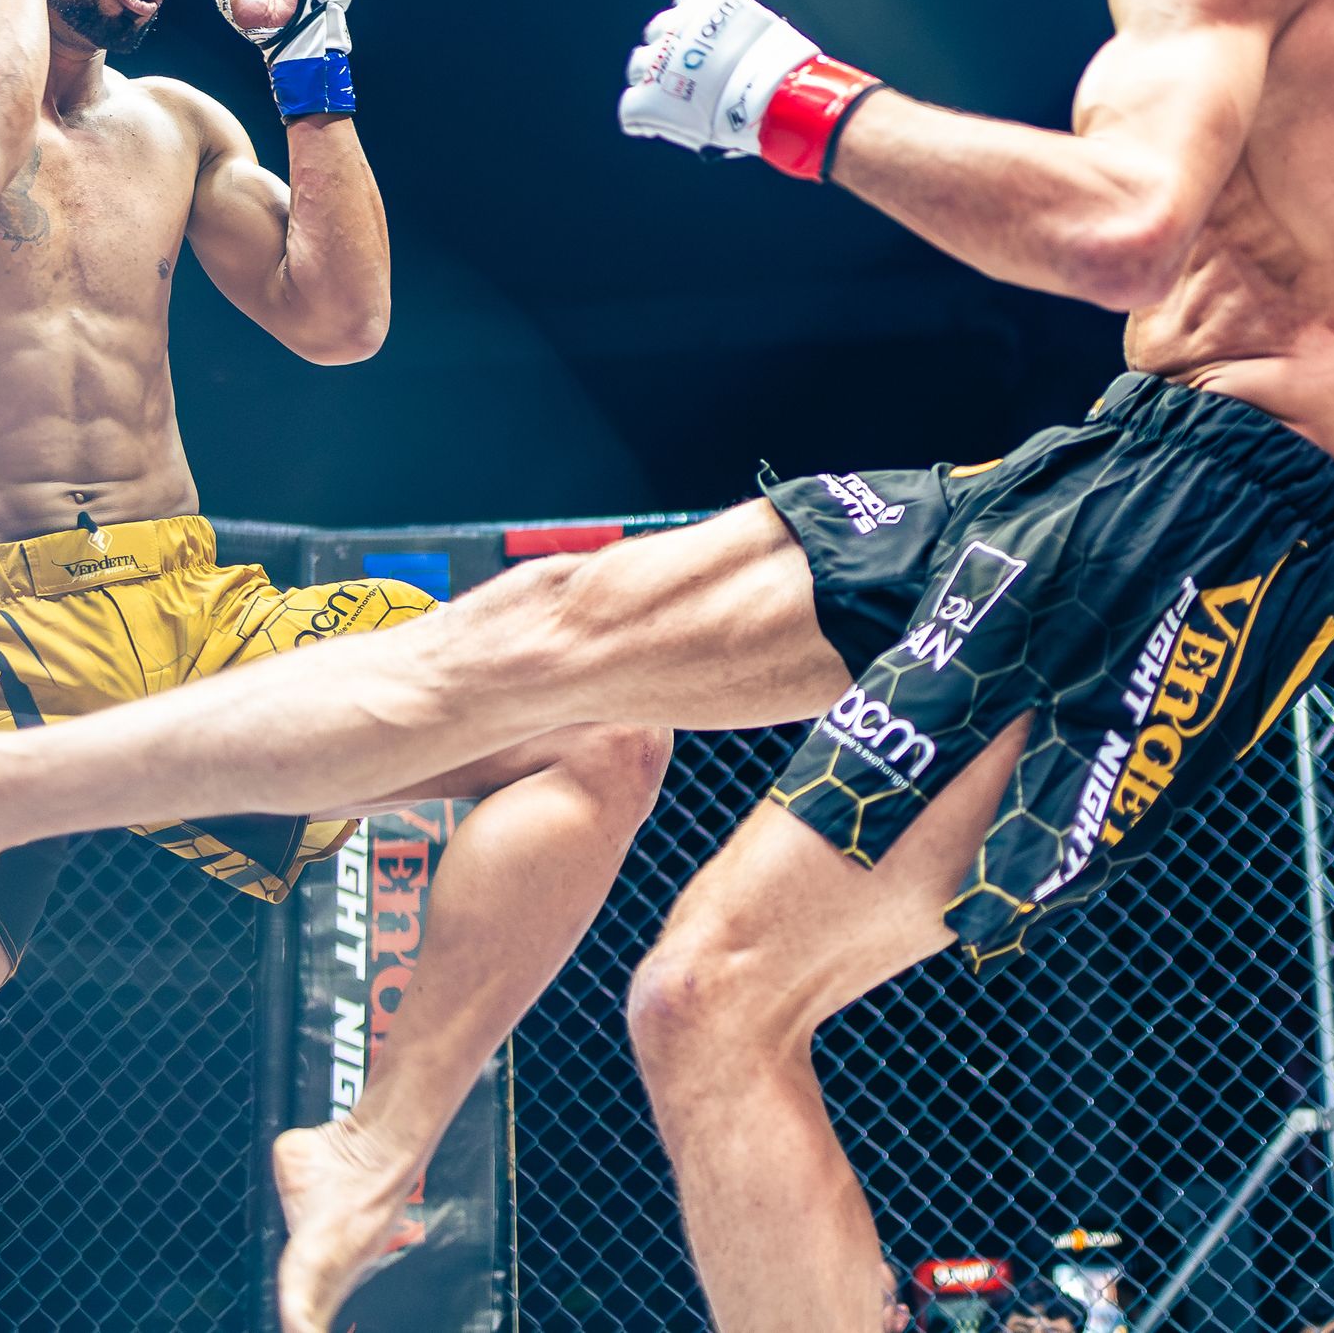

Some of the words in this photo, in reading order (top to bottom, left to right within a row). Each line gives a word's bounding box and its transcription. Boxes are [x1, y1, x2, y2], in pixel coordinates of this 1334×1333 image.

[907, 622, 964, 672] AN
[833, 684, 936, 780] acm
[330, 997, 366, 1122] NIG
